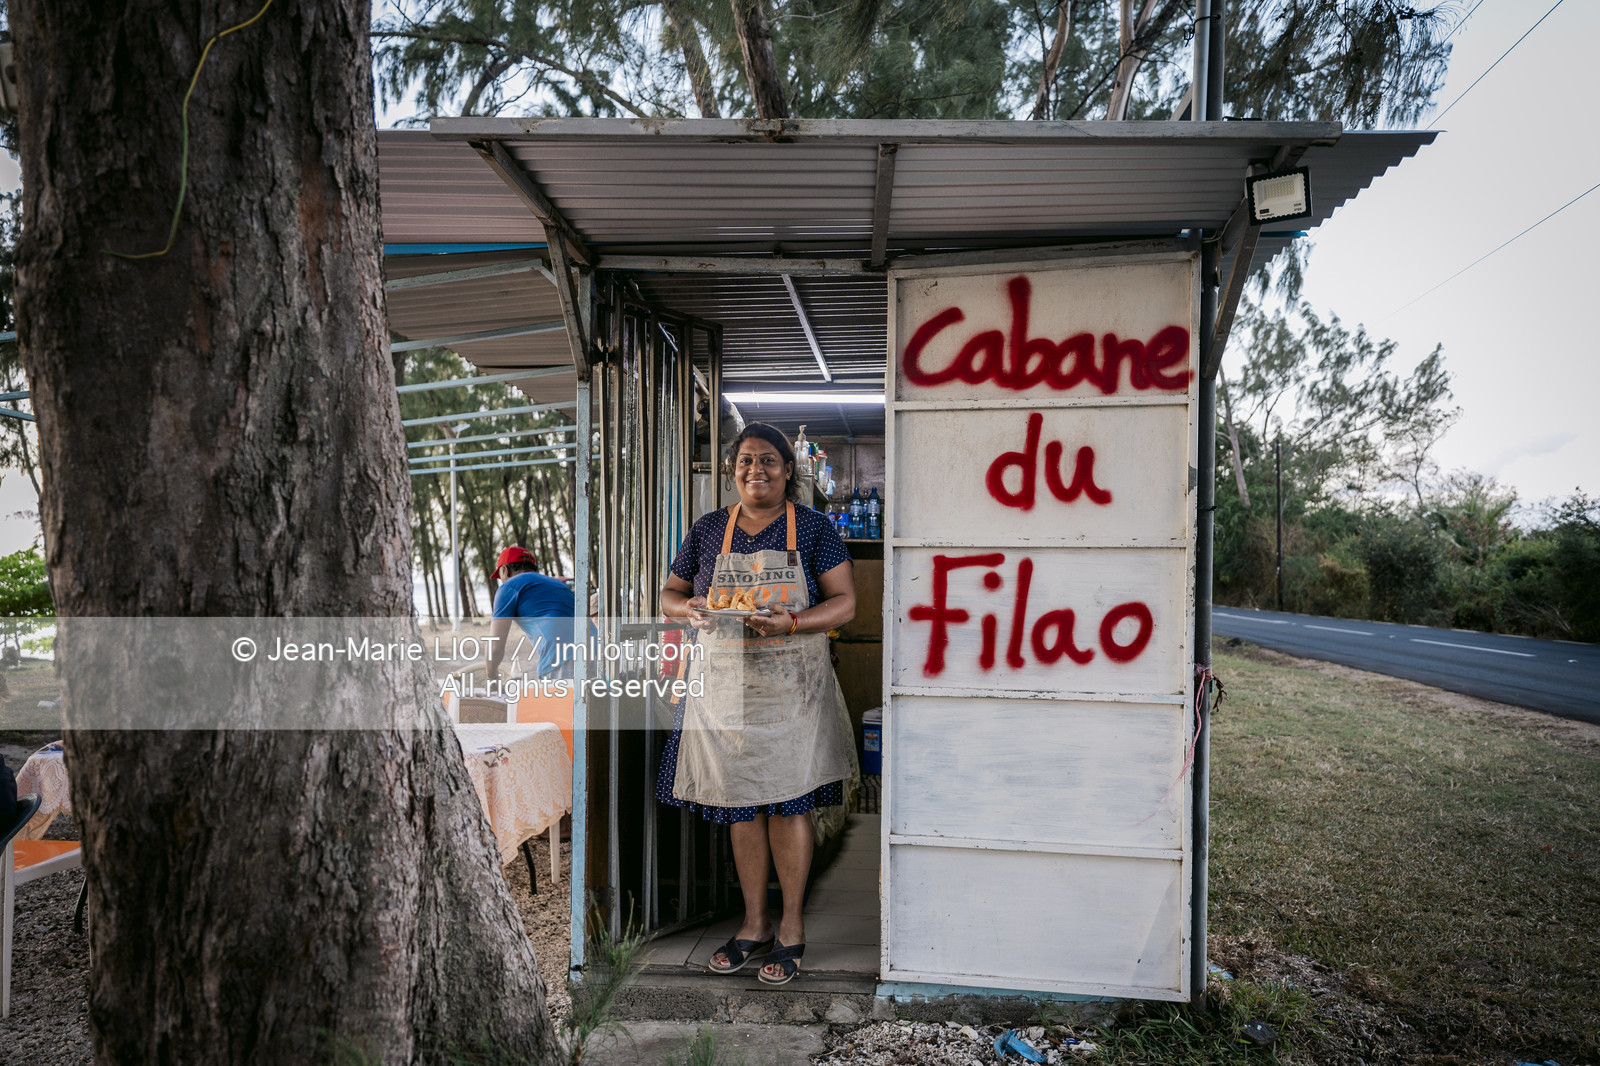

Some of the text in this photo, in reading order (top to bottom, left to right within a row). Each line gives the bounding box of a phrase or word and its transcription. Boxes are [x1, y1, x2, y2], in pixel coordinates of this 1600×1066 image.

[903, 275, 1194, 394] Cabane
[985, 412, 1113, 511] du
[717, 571, 796, 583] SMOKING
[908, 552, 1154, 677] Filao
